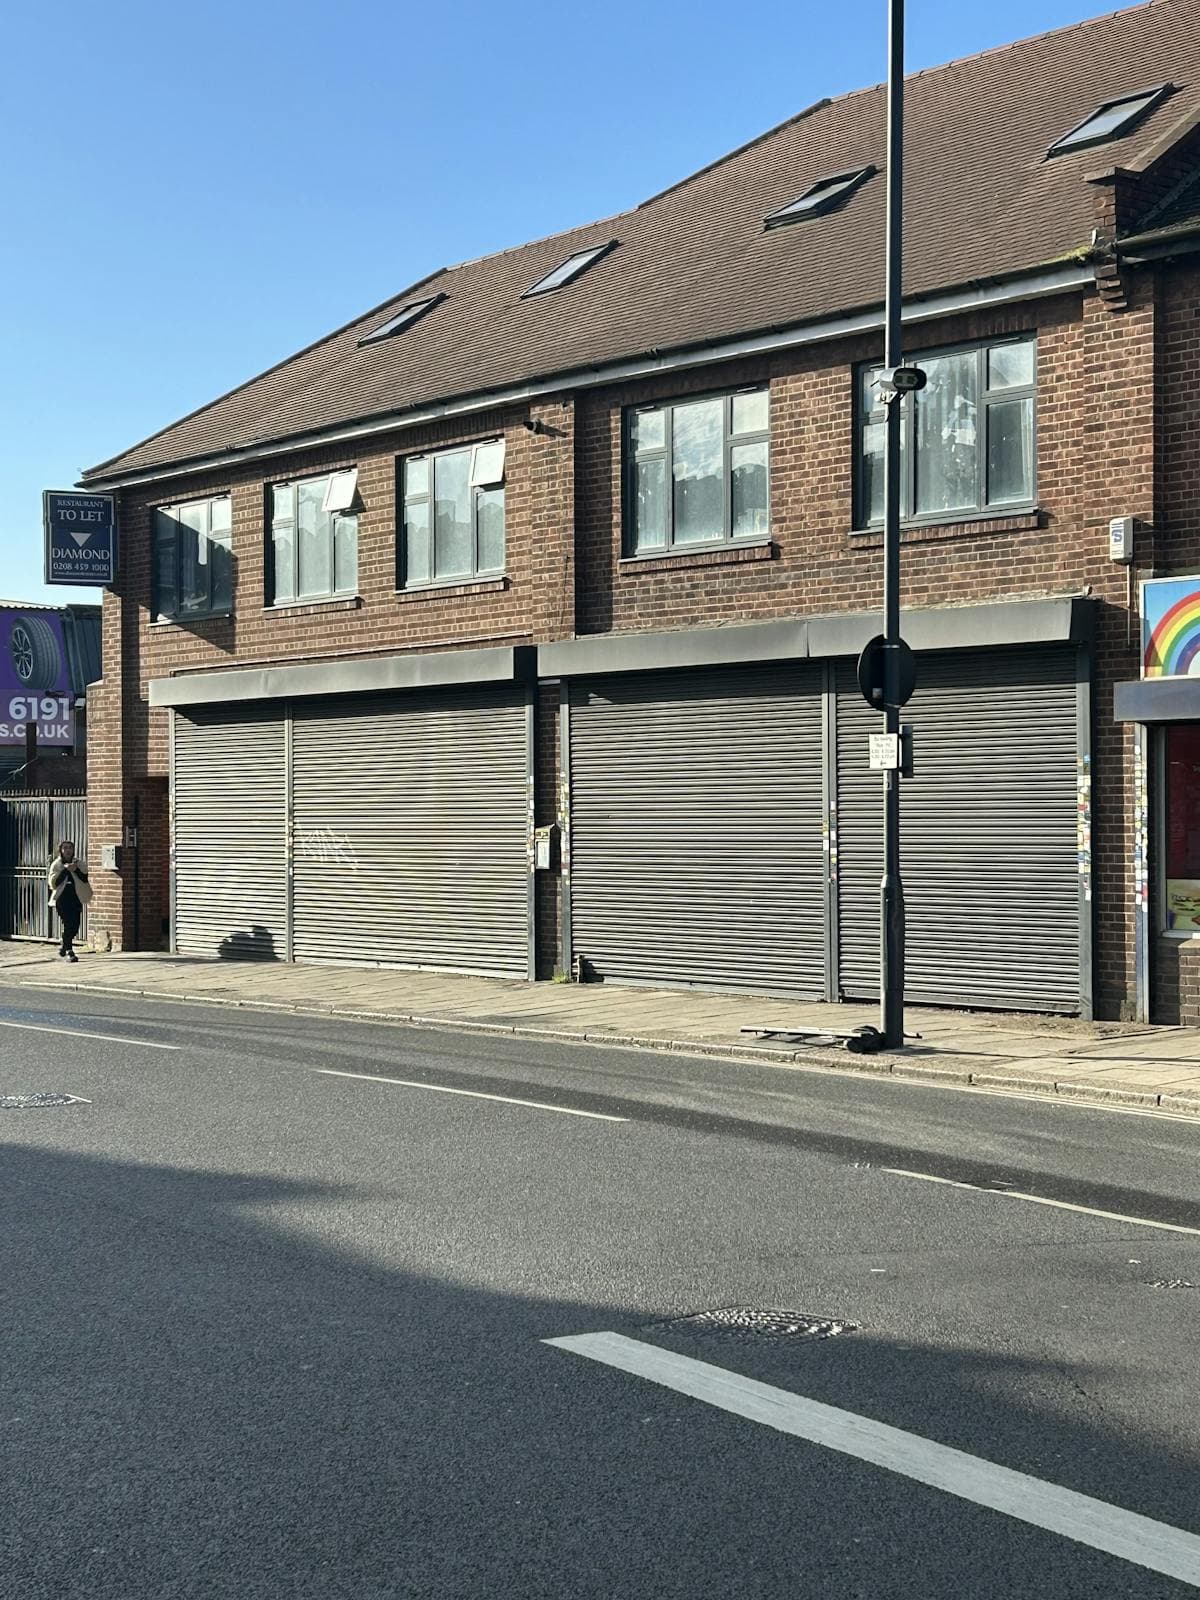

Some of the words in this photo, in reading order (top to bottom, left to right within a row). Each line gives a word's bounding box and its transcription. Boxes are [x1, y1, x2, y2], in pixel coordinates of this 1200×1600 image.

[58, 500, 103, 508] RESTAURANT
[58, 510, 77, 520] TO
[80, 511, 104, 521] LET
[52, 547, 110, 560] DIAMOND
[53, 562, 73, 570] 0208
[92, 563, 109, 572] 1000
[9, 696, 70, 721] 6191
[0, 723, 69, 738] S.C.UK
